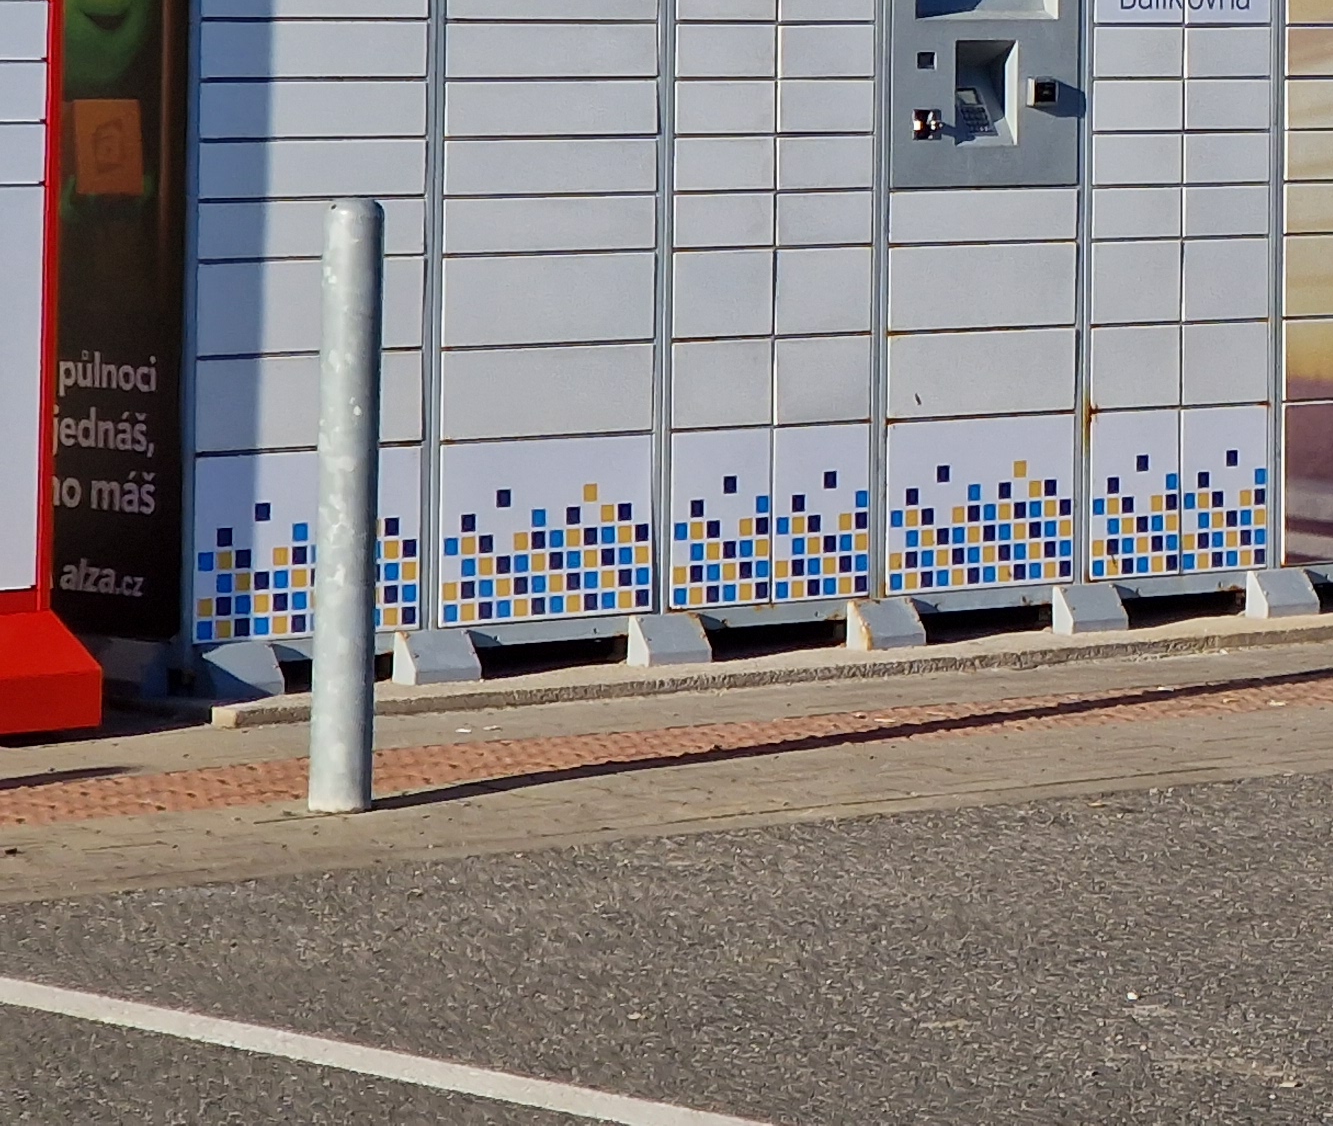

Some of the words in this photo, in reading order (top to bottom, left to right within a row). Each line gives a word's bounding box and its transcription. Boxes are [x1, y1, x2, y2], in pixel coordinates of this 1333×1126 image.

[58, 349, 158, 397] půlnoci
[53, 404, 156, 459] jednáš,
[90, 470, 157, 515] máš
[59, 558, 145, 598] alza.cz
